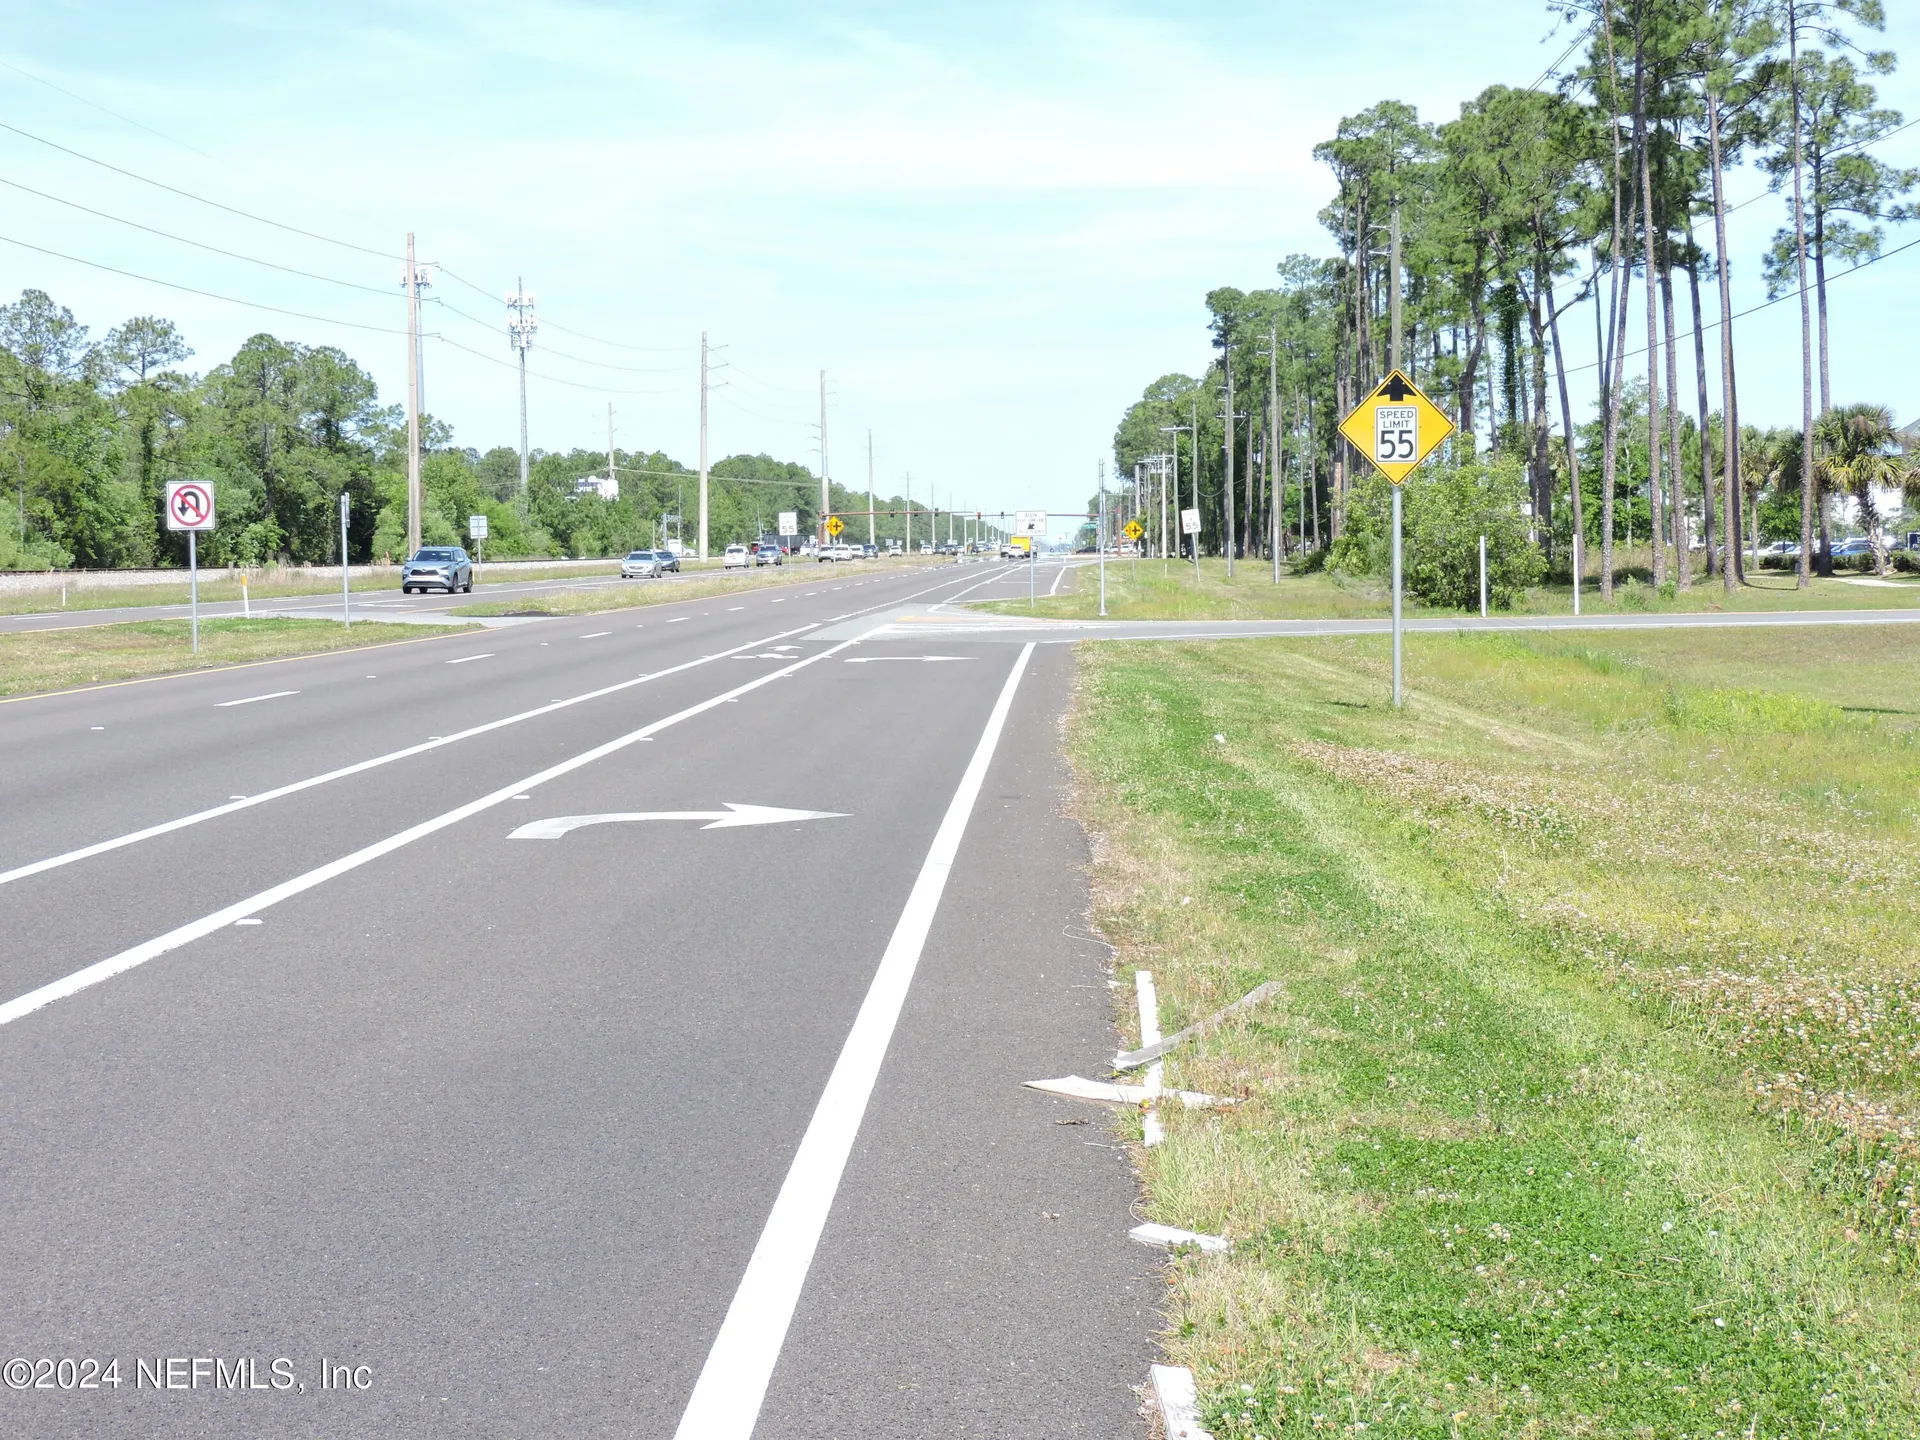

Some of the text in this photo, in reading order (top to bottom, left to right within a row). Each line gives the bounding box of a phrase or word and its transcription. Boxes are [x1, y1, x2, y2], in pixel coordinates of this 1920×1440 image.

[1379, 410, 1414, 419] SPEED
[1382, 420, 1410, 429] LIMIT
[1380, 429, 1414, 459] 55
[782, 525, 795, 534] 55
[1185, 521, 1199, 531] 55
